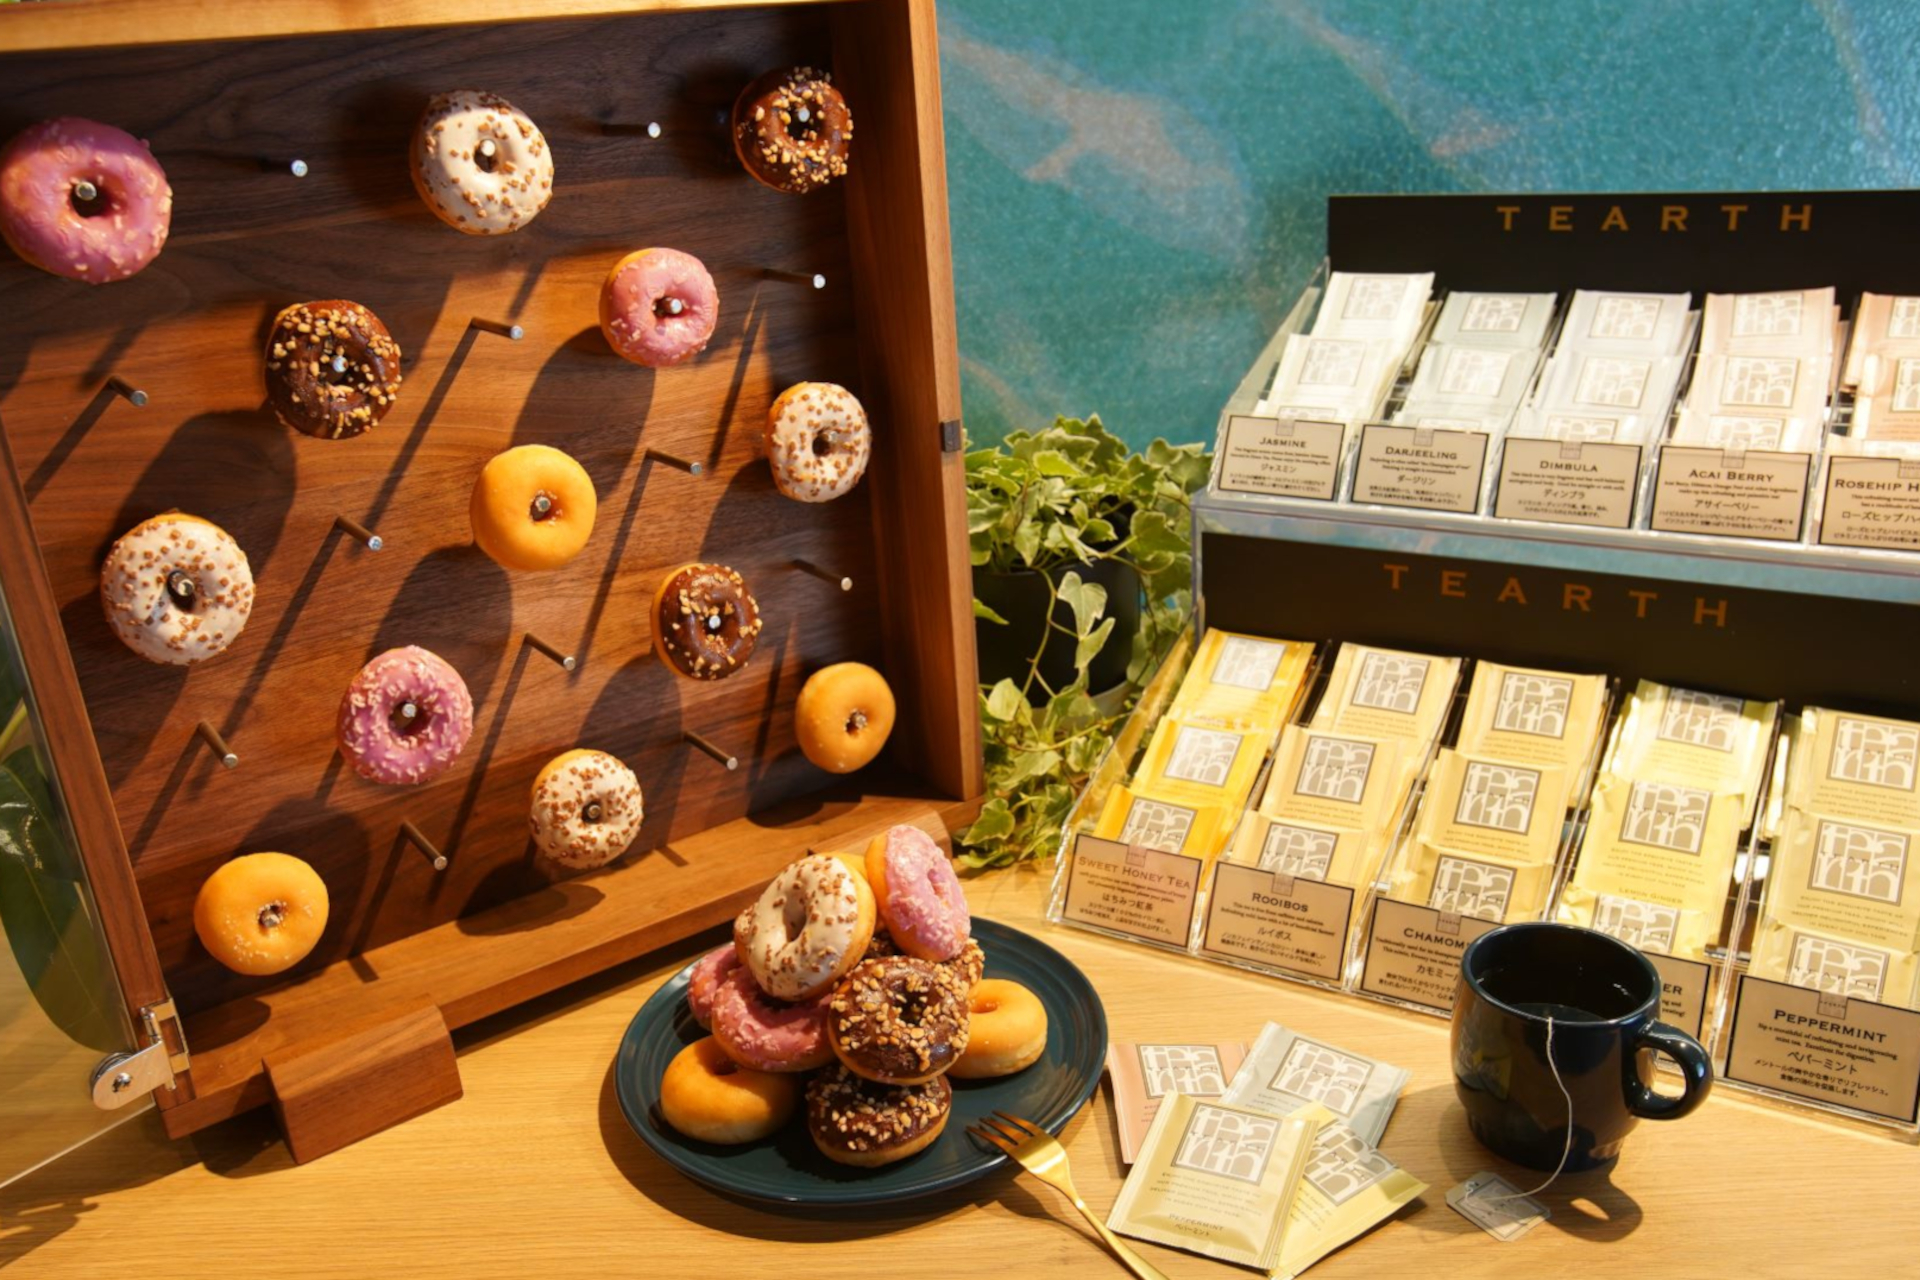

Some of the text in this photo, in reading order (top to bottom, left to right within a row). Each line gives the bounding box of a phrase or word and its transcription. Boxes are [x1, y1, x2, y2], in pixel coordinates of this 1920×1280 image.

[1497, 204, 1812, 231] TEARTH
[1259, 437, 1306, 448] JASMINE
[1385, 446, 1457, 460] DARJEELING
[1260, 463, 1296, 473] ジャスミン
[1539, 460, 1597, 472] DIMBULA
[1397, 474, 1436, 486] ダージリン
[1688, 468, 1774, 483] ACAI BERRY
[1835, 478, 1901, 491] ROSEHIP
[1694, 499, 1759, 512] アサイーベリー
[1384, 564, 1727, 627] TEARTH
[1078, 855, 1117, 873] SWEET
[1122, 865, 1163, 884] HONEY
[1166, 875, 1191, 890] TEA
[1102, 892, 1153, 912] はちみつ紅茶
[1252, 892, 1308, 913] ROOIBOS
[1403, 927, 1468, 951] CHAMOM
[1773, 1009, 1886, 1043] PEPPERMINT
[1786, 1049, 1857, 1075] ペパーミント
